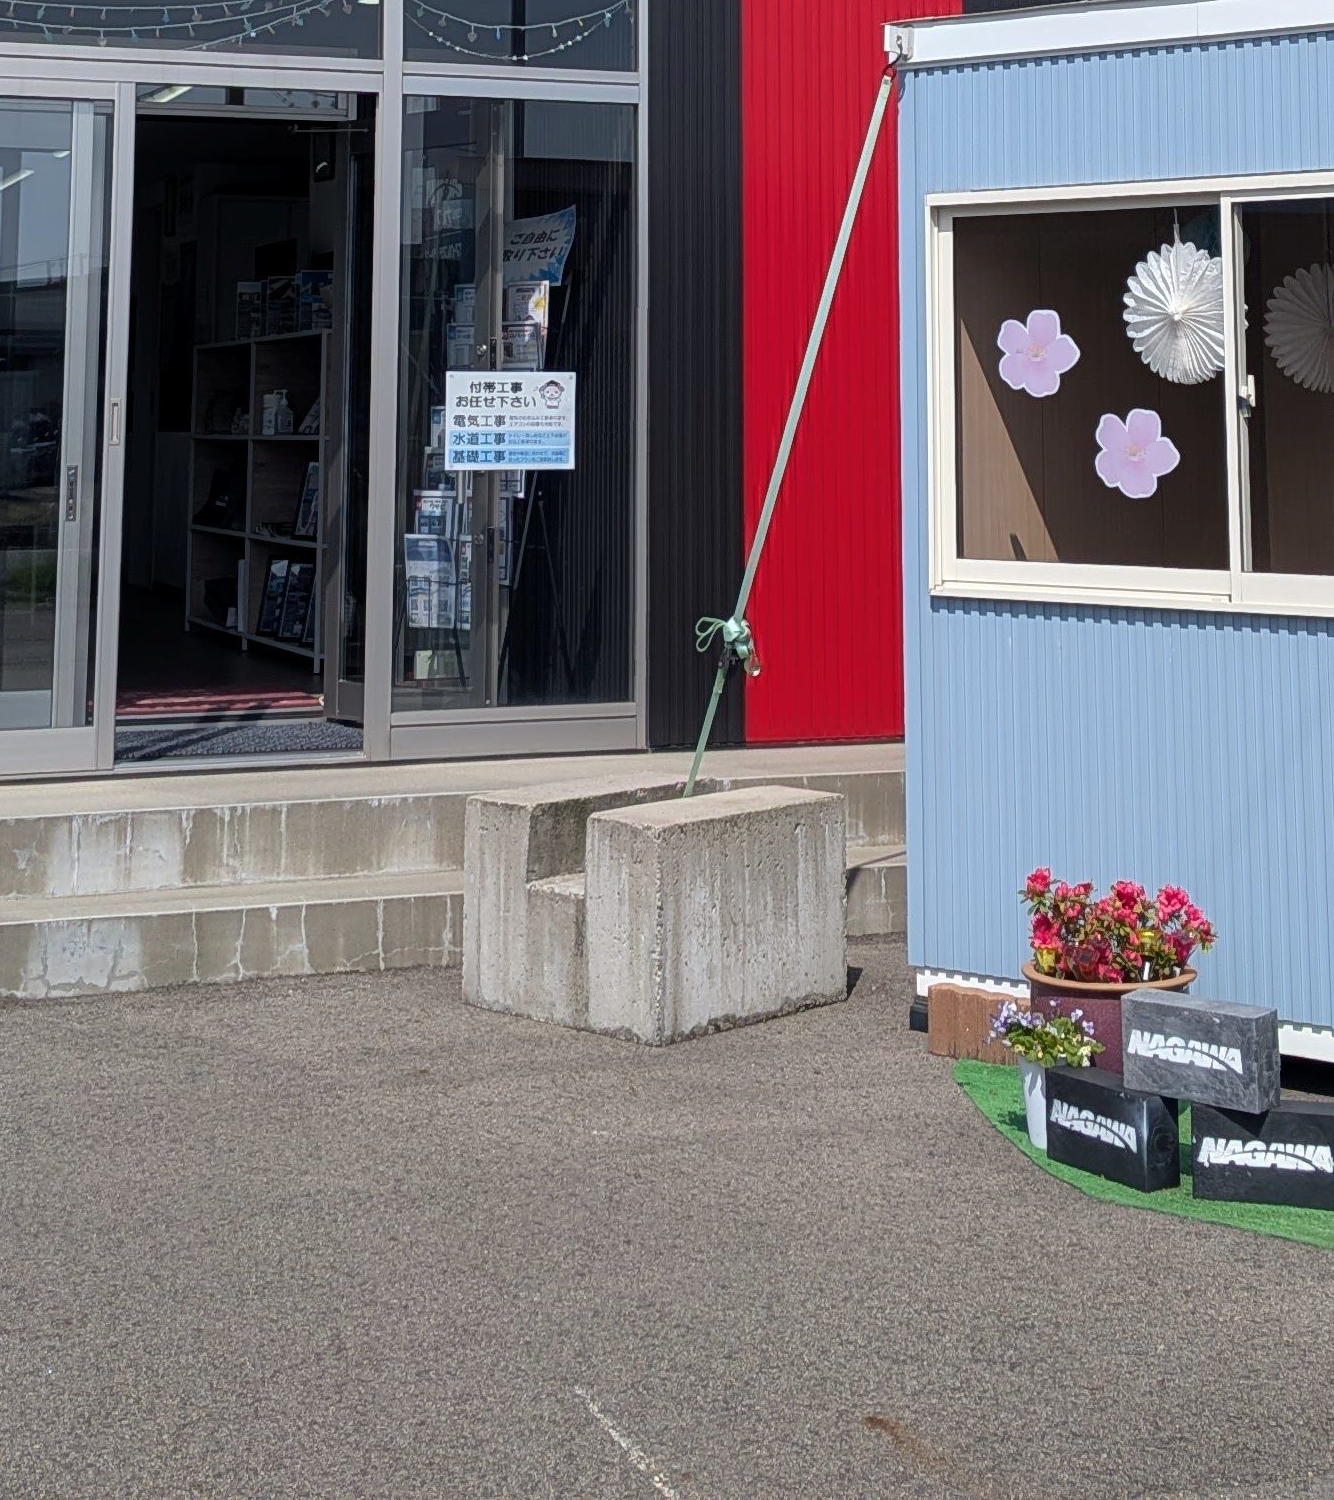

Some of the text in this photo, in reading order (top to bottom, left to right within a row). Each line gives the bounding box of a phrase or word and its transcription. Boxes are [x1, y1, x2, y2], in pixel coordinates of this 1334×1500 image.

[510, 229, 560, 245] ご自由に
[469, 381, 523, 394] 付帯工事
[455, 395, 537, 409] お任せ下さい
[452, 414, 507, 428] 電気工事
[452, 432, 507, 446] 水道工事
[452, 450, 506, 463] 基礎工事
[1127, 1028, 1244, 1075] NAGAWA
[1049, 1098, 1138, 1154] NAGAWA
[1196, 1136, 1334, 1174] NAGAWA
